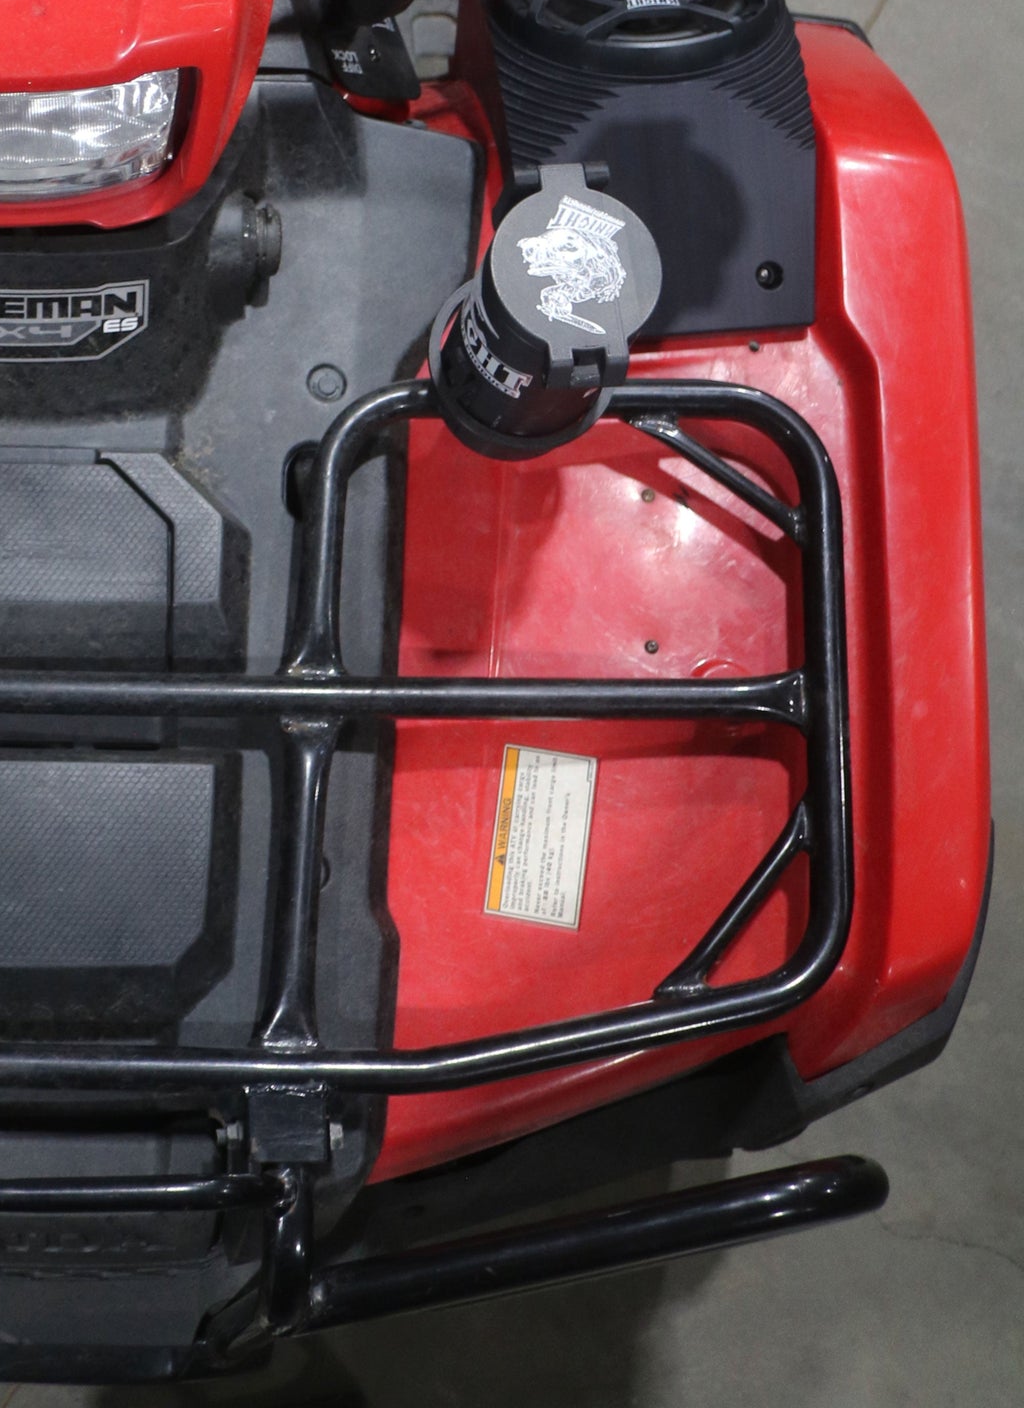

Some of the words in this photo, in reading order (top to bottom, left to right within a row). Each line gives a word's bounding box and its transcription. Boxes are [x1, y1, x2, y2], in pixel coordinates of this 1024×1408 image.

[331, 49, 359, 63] LOCK
[551, 207, 619, 238] KNIGHT
[103, 317, 138, 334] ES
[496, 796, 512, 850] WARNING
